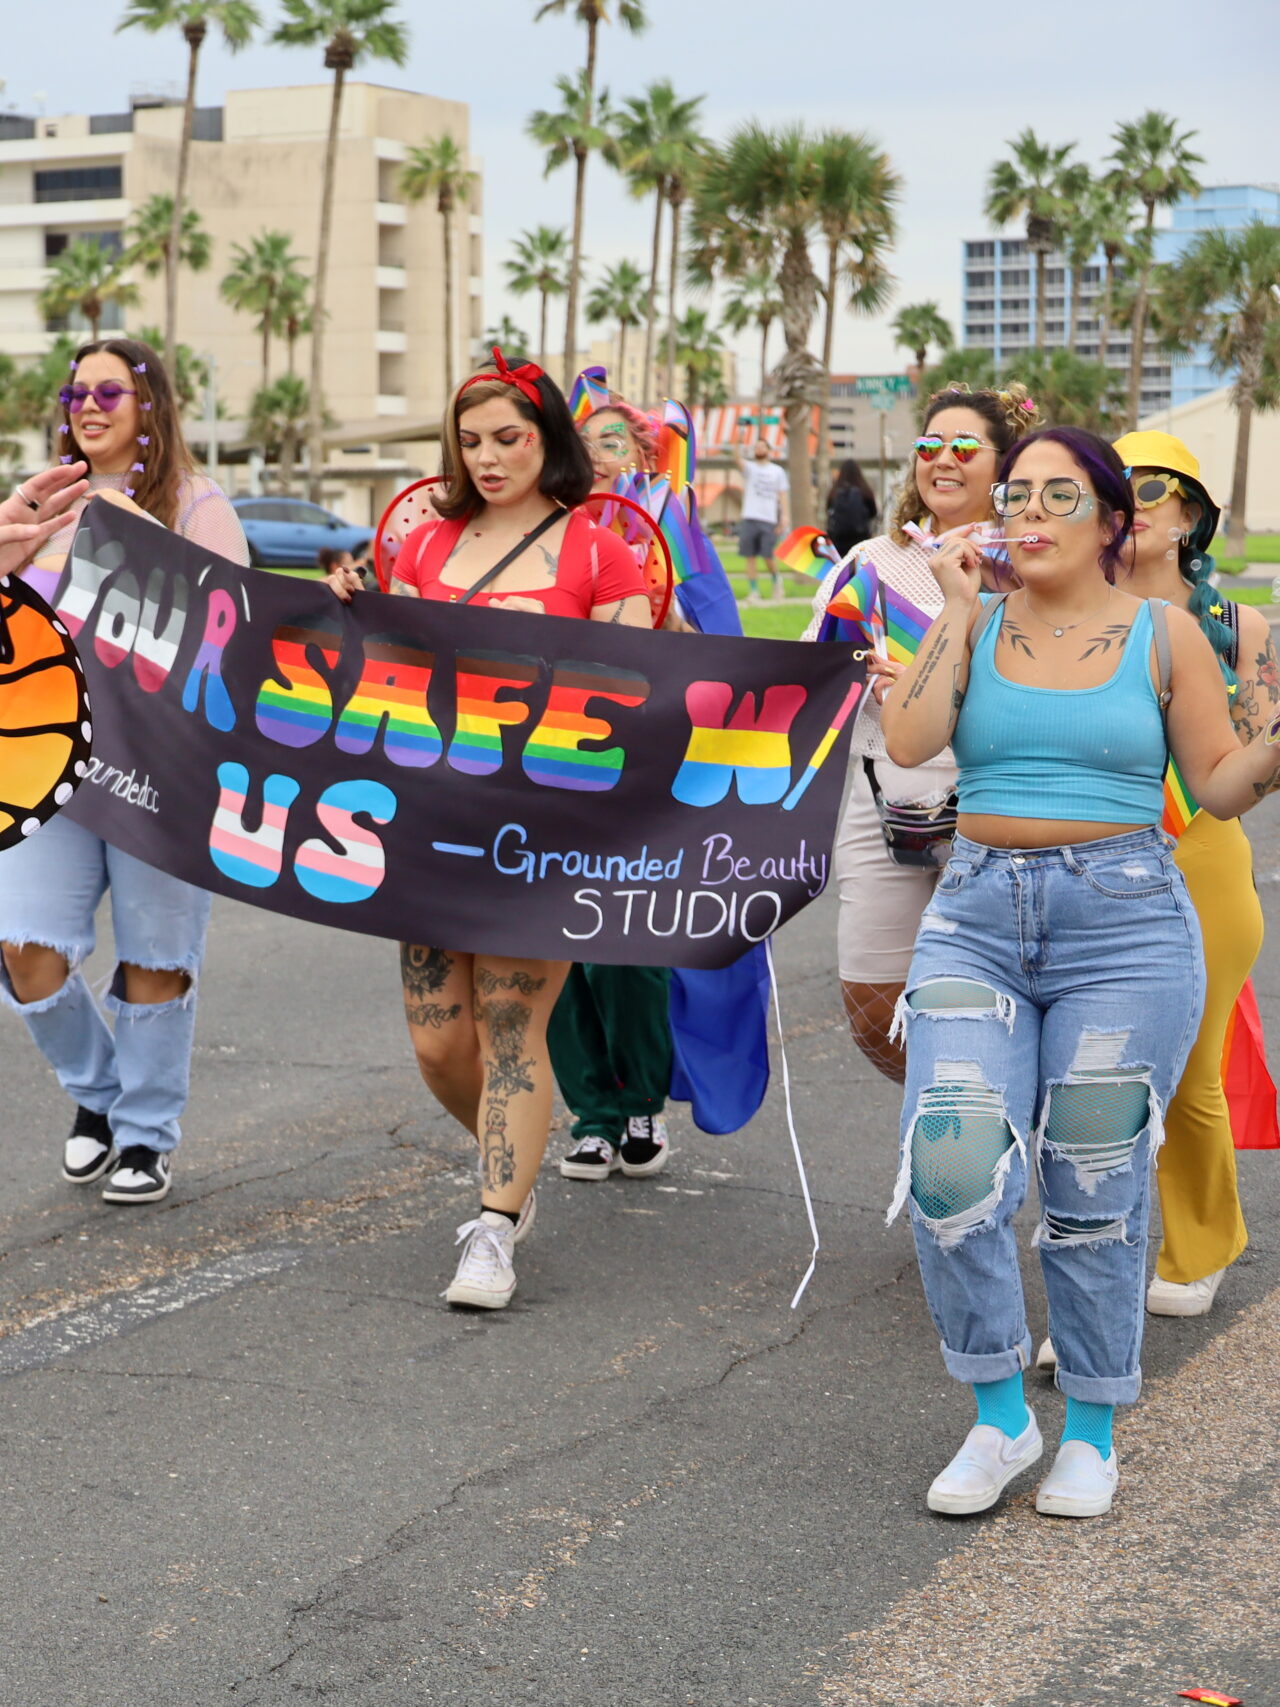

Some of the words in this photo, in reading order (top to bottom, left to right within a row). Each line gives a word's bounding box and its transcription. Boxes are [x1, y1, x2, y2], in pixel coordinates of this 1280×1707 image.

[255, 614, 651, 792] SAFE
[210, 761, 397, 903] US
[493, 823, 685, 883] Grounded
[701, 833, 827, 896] Beauty
[562, 887, 782, 942] STUDIO
